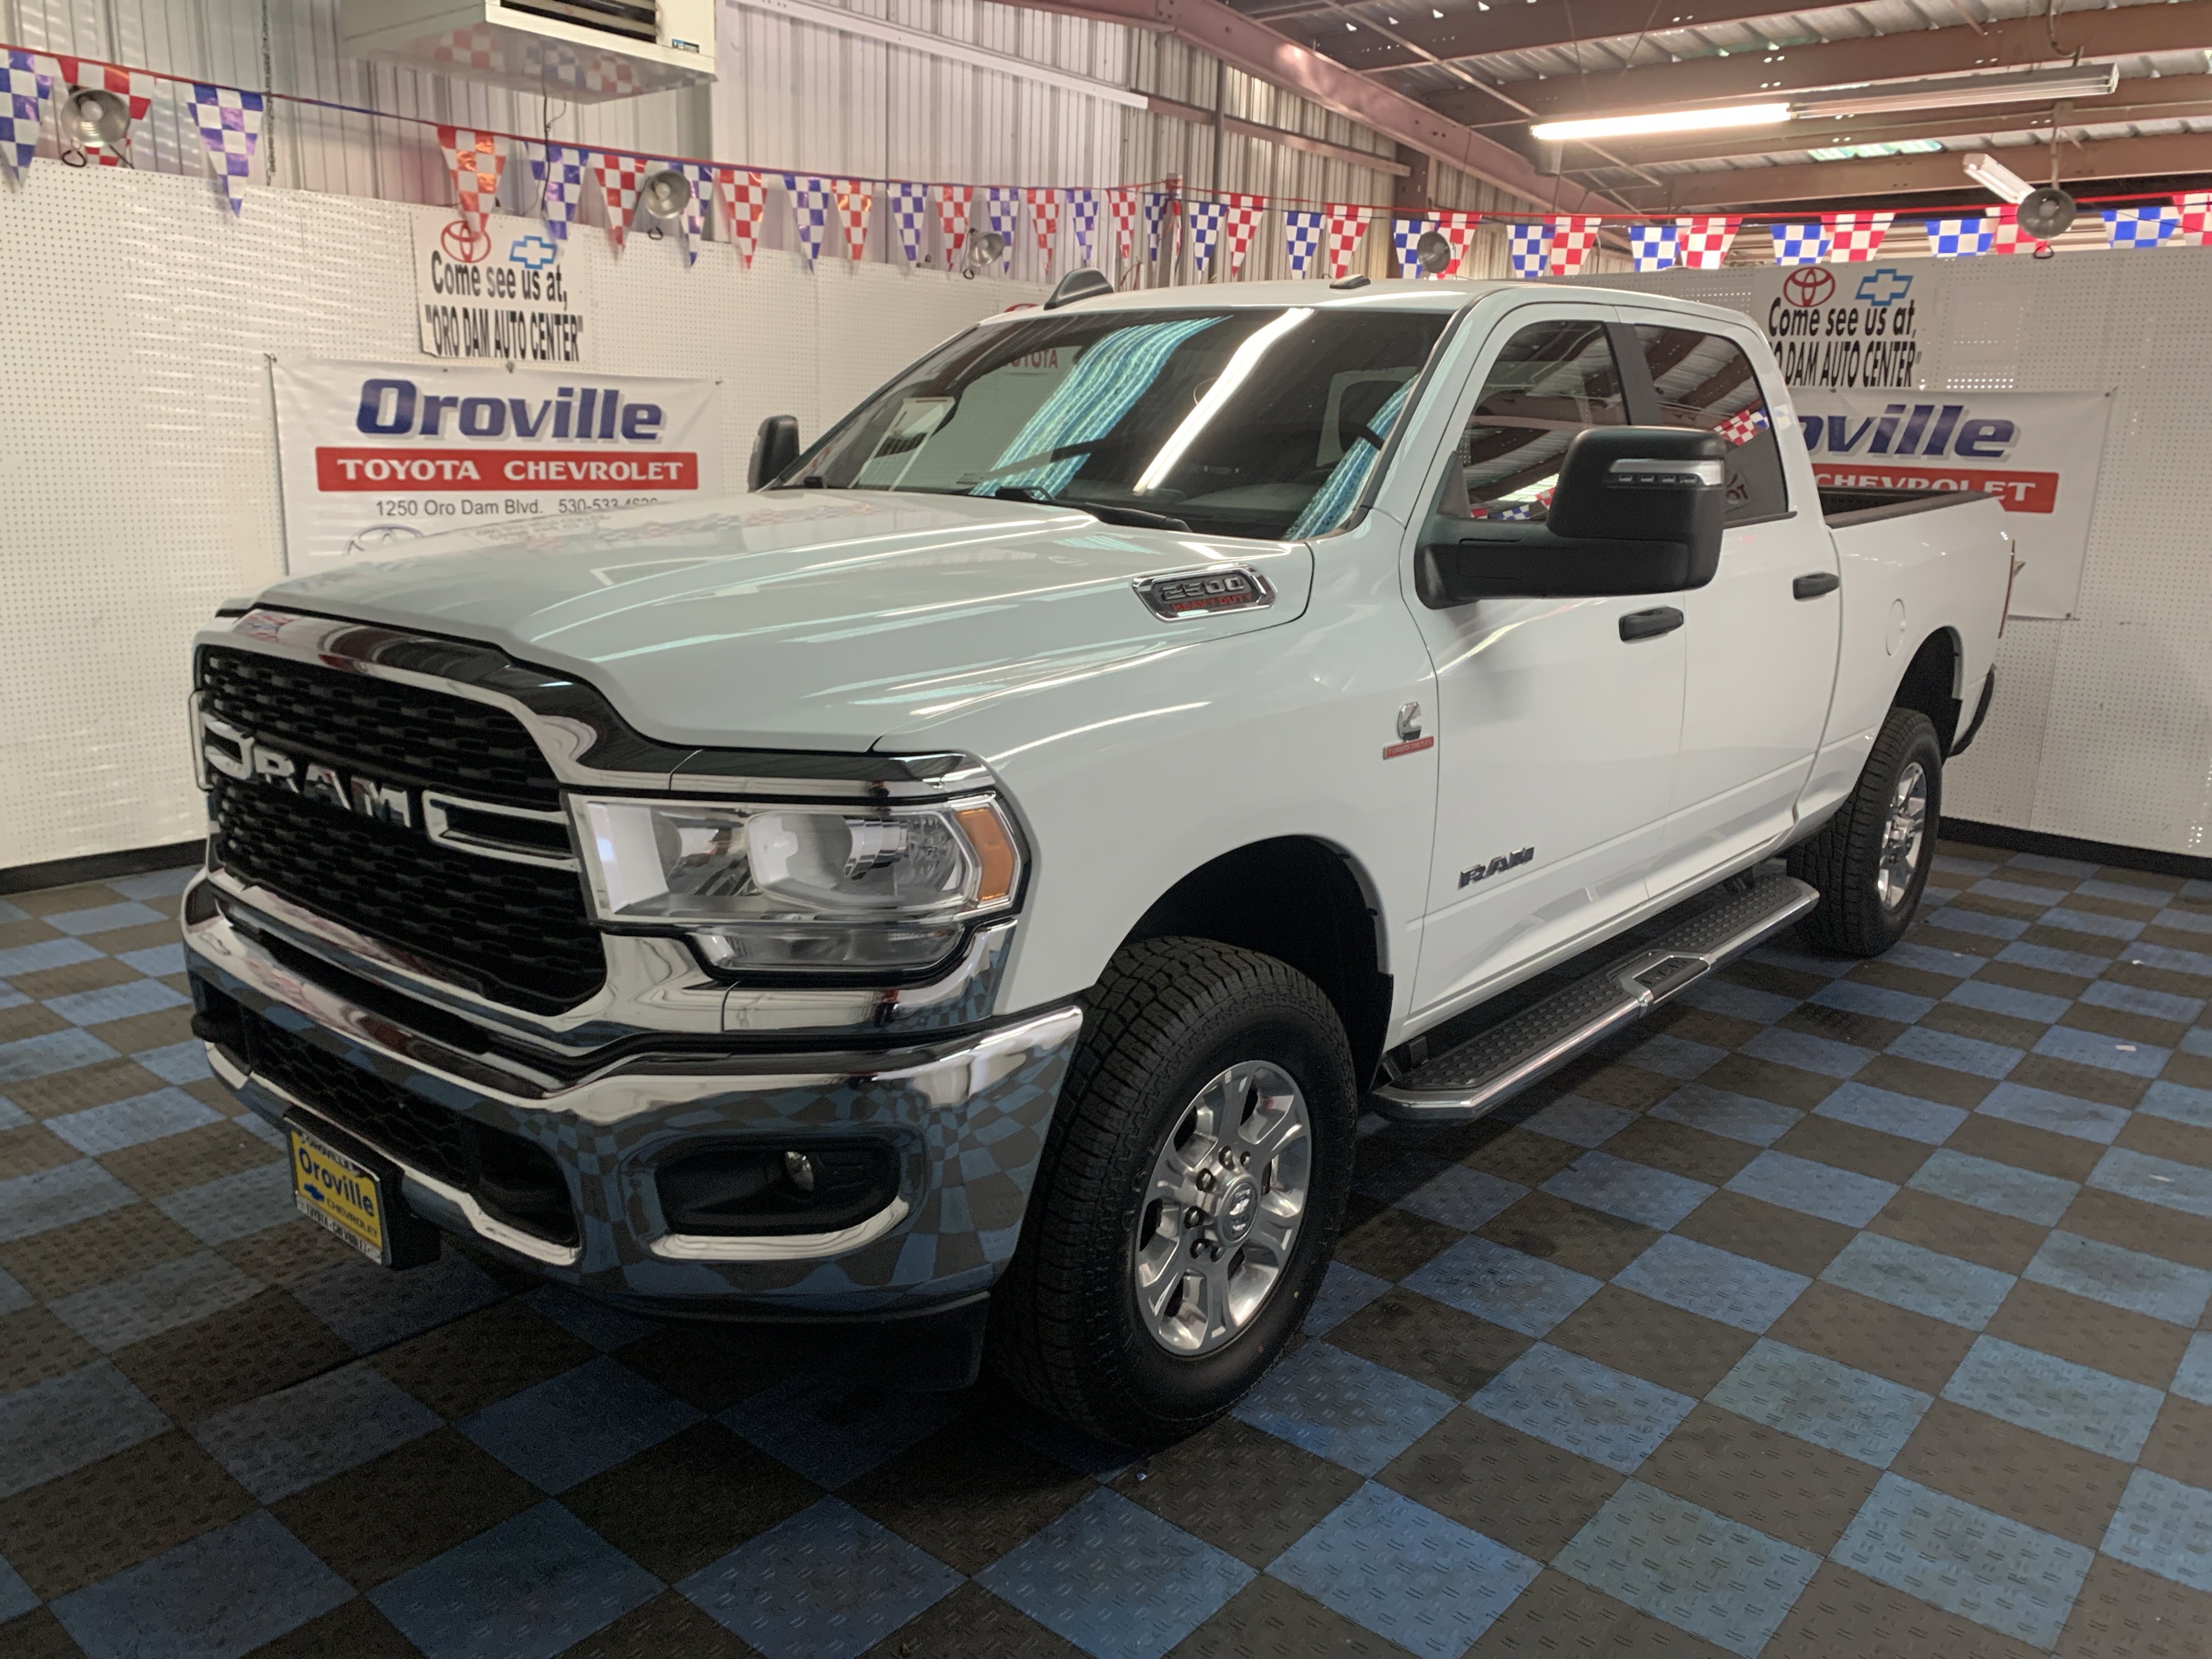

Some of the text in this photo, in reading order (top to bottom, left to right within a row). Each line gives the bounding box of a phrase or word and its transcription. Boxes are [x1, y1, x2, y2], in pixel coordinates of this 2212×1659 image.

[432, 250, 567, 311] Come see us at,
[425, 304, 583, 362] "ORO DAM AUTO CENTER"
[1769, 297, 1916, 339] Come see us at,
[1785, 341, 1820, 386] DAM
[1819, 340, 1860, 388] AUTO
[357, 379, 663, 440] Oroville
[1798, 404, 2016, 458] ville
[337, 459, 683, 481] TOYOTA CHEVROLET
[376, 500, 417, 516] 1250
[424, 499, 456, 516] Oro
[462, 499, 499, 515] Dam
[505, 498, 544, 515] Blvd.
[1160, 577, 1244, 601] 2500
[1170, 593, 1252, 612] HEAVY DUTY
[254, 747, 410, 828] RAM
[1458, 845, 1534, 891] RAM
[299, 1147, 375, 1217] Oroville
